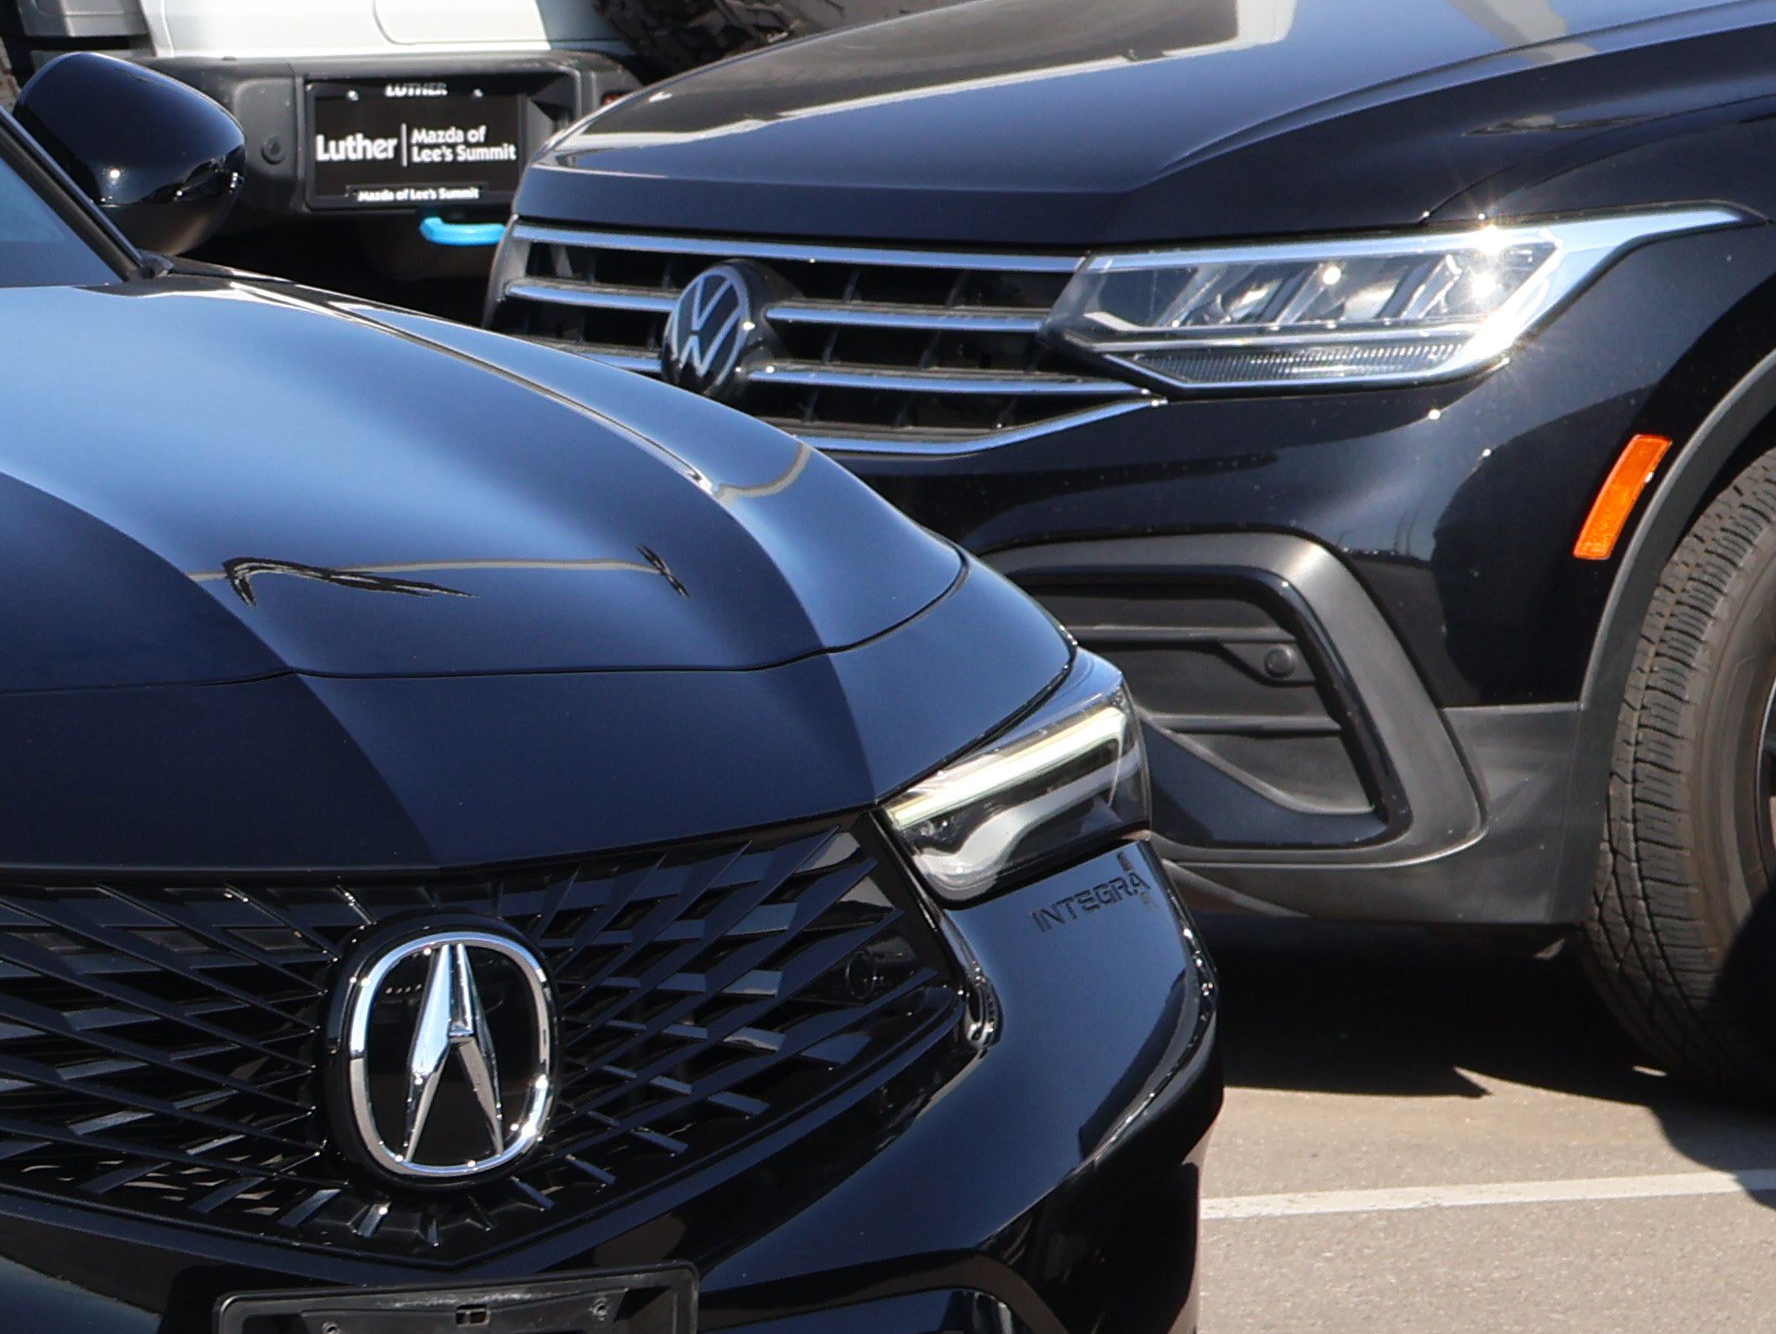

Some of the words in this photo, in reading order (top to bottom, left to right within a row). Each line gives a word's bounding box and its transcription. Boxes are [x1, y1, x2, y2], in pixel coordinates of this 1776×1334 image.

[384, 82, 448, 98] LUTHER
[411, 127, 464, 145] Mazda
[466, 125, 487, 142] of
[315, 132, 398, 162] Luther
[411, 146, 453, 163] Lee's
[455, 143, 517, 162] Summit
[357, 189, 394, 202] Mazda
[395, 187, 410, 201] of
[410, 187, 437, 200] Lee's
[438, 186, 480, 199] Summit
[1029, 871, 1152, 934] INTEGRA
